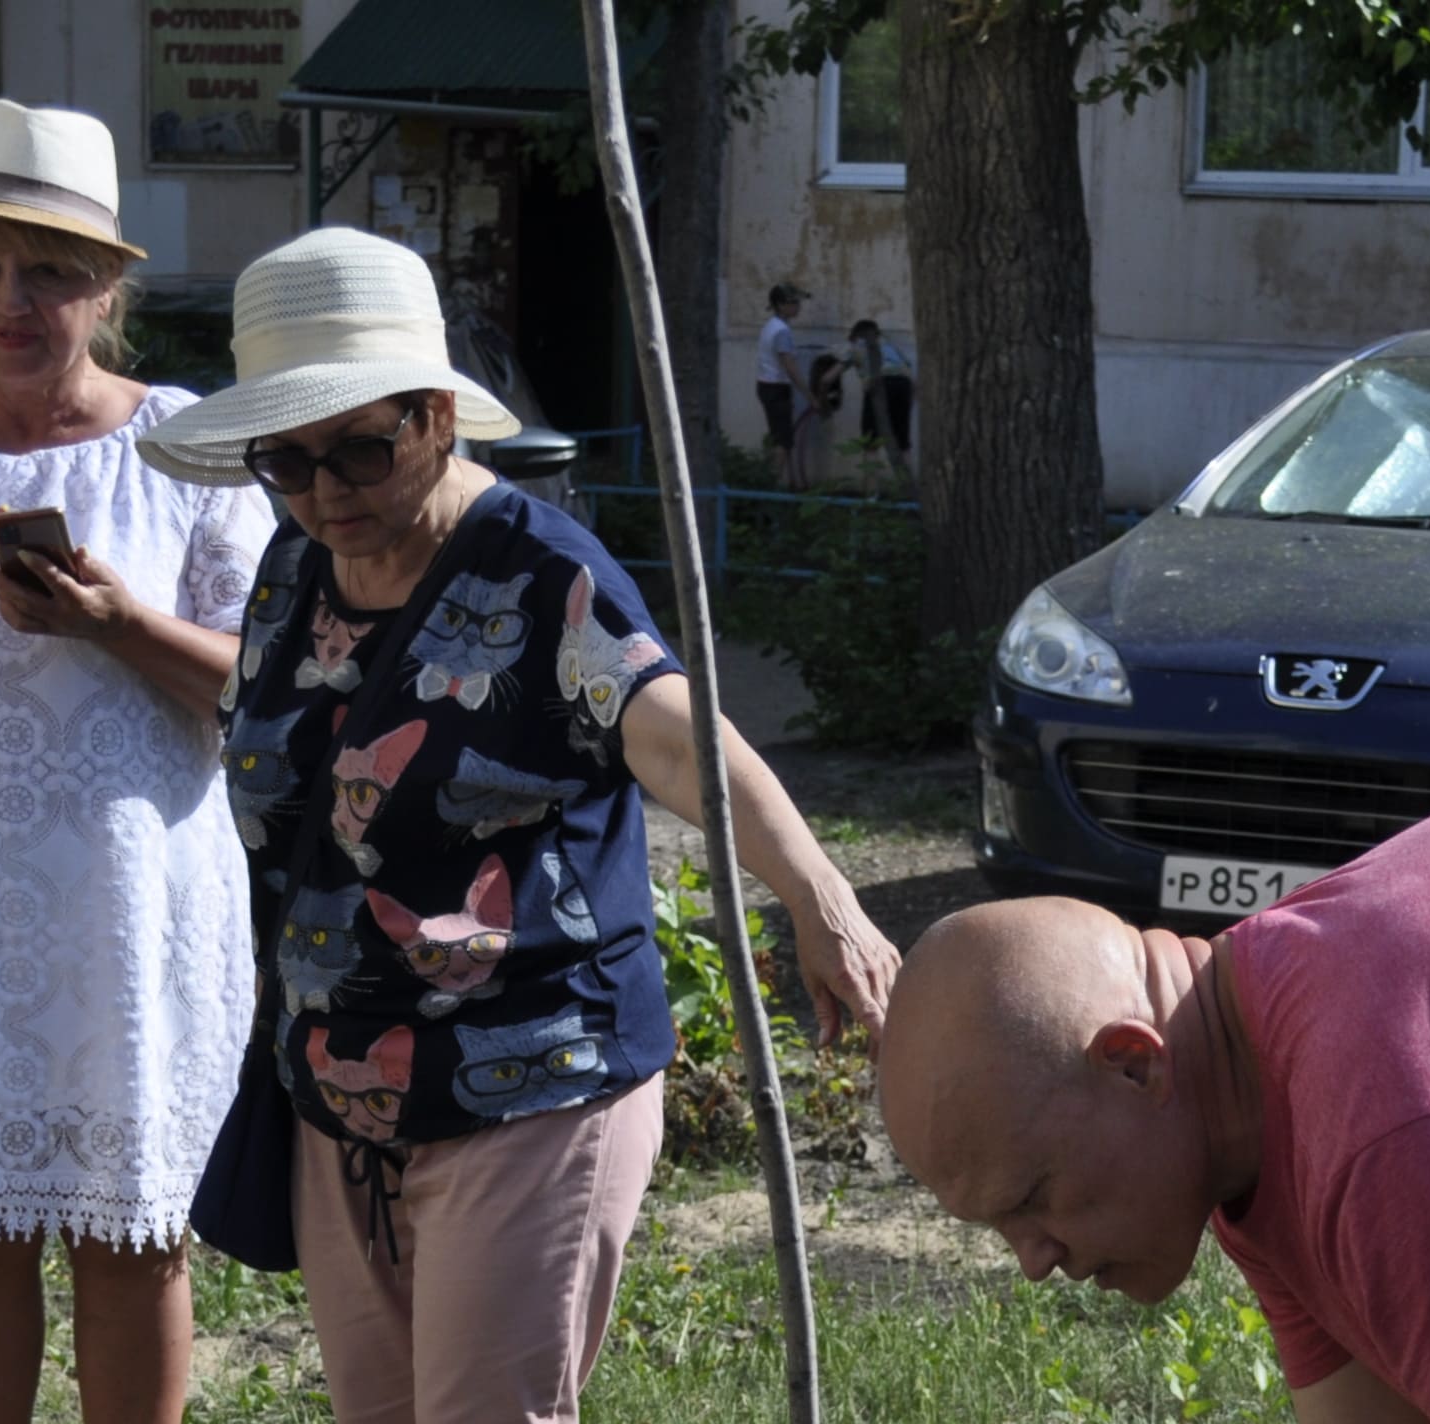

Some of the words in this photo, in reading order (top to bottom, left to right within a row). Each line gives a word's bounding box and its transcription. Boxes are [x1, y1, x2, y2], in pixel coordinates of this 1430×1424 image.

[150, 8, 301, 30] ФОТОПЕЧАТЬ
[163, 43, 284, 65] ГЕЛИЕВЫЕ
[187, 78, 261, 100] ШАРЫ
[1178, 866, 1305, 908] Р851
